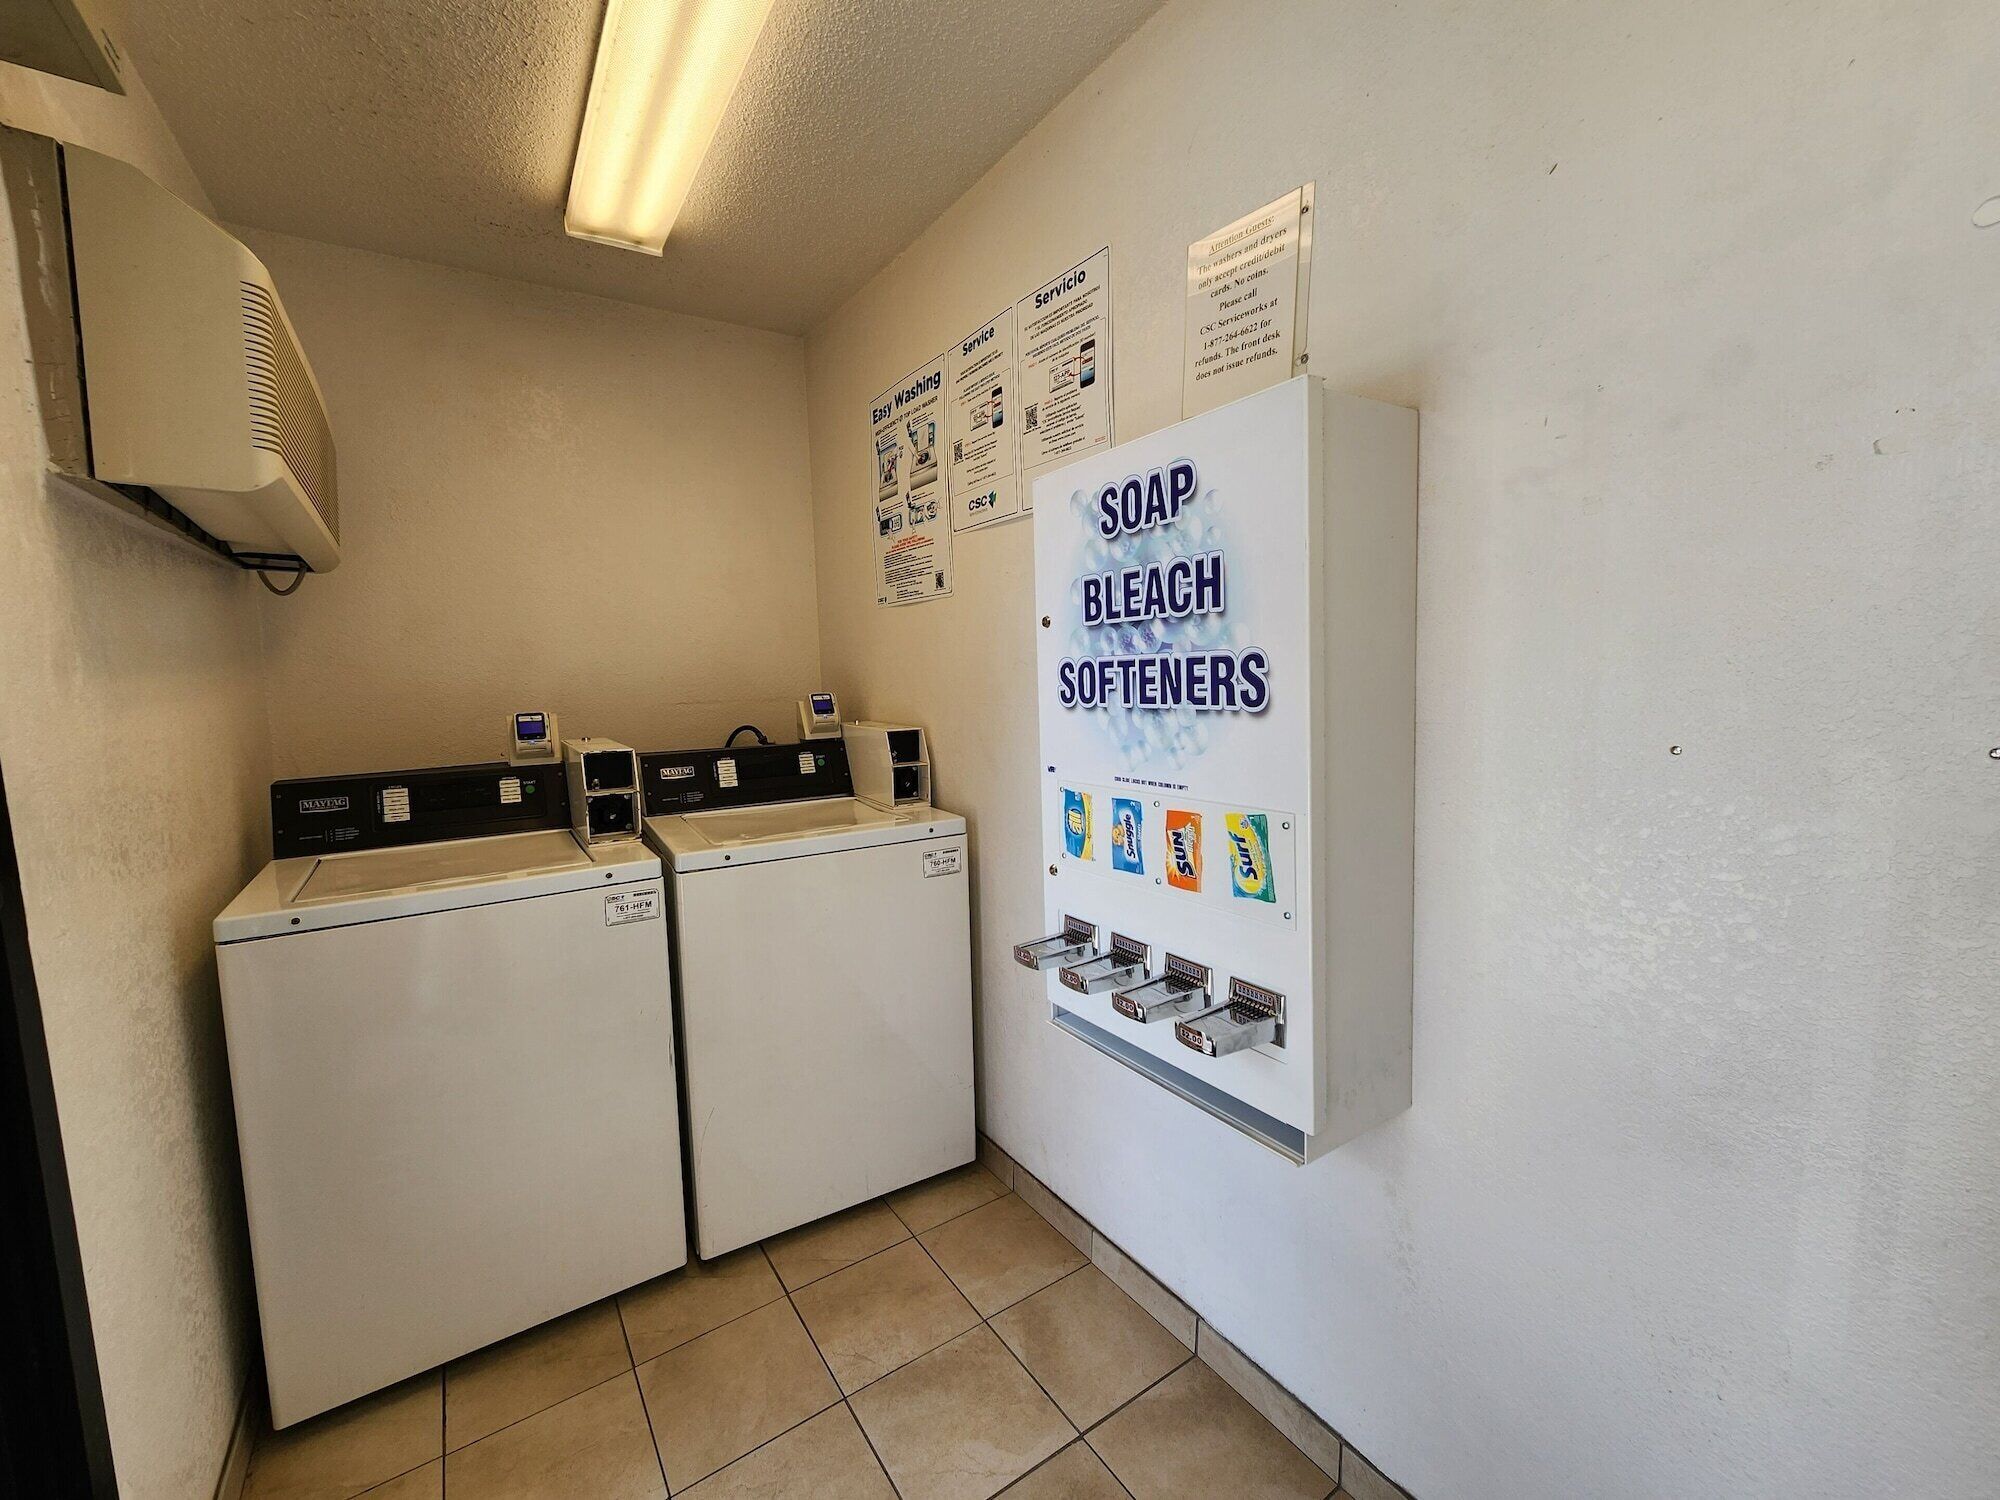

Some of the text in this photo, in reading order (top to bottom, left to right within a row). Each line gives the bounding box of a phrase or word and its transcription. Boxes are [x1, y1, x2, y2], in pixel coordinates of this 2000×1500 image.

[1198, 228, 1287, 275] The washers and dryers
[1209, 215, 1275, 255] Attention Guests:
[1198, 244, 1285, 290] only accept credit/debit
[1210, 268, 1269, 298] cards. No coins.
[1035, 270, 1086, 309] Servicio
[1219, 288, 1257, 312] Please call
[1200, 297, 1278, 336] CSC Serviceworks at
[1203, 318, 1273, 351] 1-877-264-6622 for
[962, 327, 994, 356] Service
[1195, 330, 1281, 368] refunds. The front desk
[1195, 347, 1278, 381] does not issue refunds.
[873, 400, 893, 425] Easy
[894, 371, 941, 410] Washing
[969, 495, 987, 511] CSC
[1099, 461, 1195, 537] SOAP
[1082, 555, 1223, 623] BLEACH
[1059, 651, 1266, 709] SOFTENERS
[662, 768, 692, 776] MAYTAG
[303, 799, 345, 808] MAYTAG
[1069, 809, 1082, 835] all
[1124, 814, 1136, 858] Snuggle
[1172, 831, 1194, 876] SUN
[1228, 831, 1258, 880] Surf
[615, 901, 652, 913] 761-HFM
[1181, 1029, 1202, 1044] $2.00
